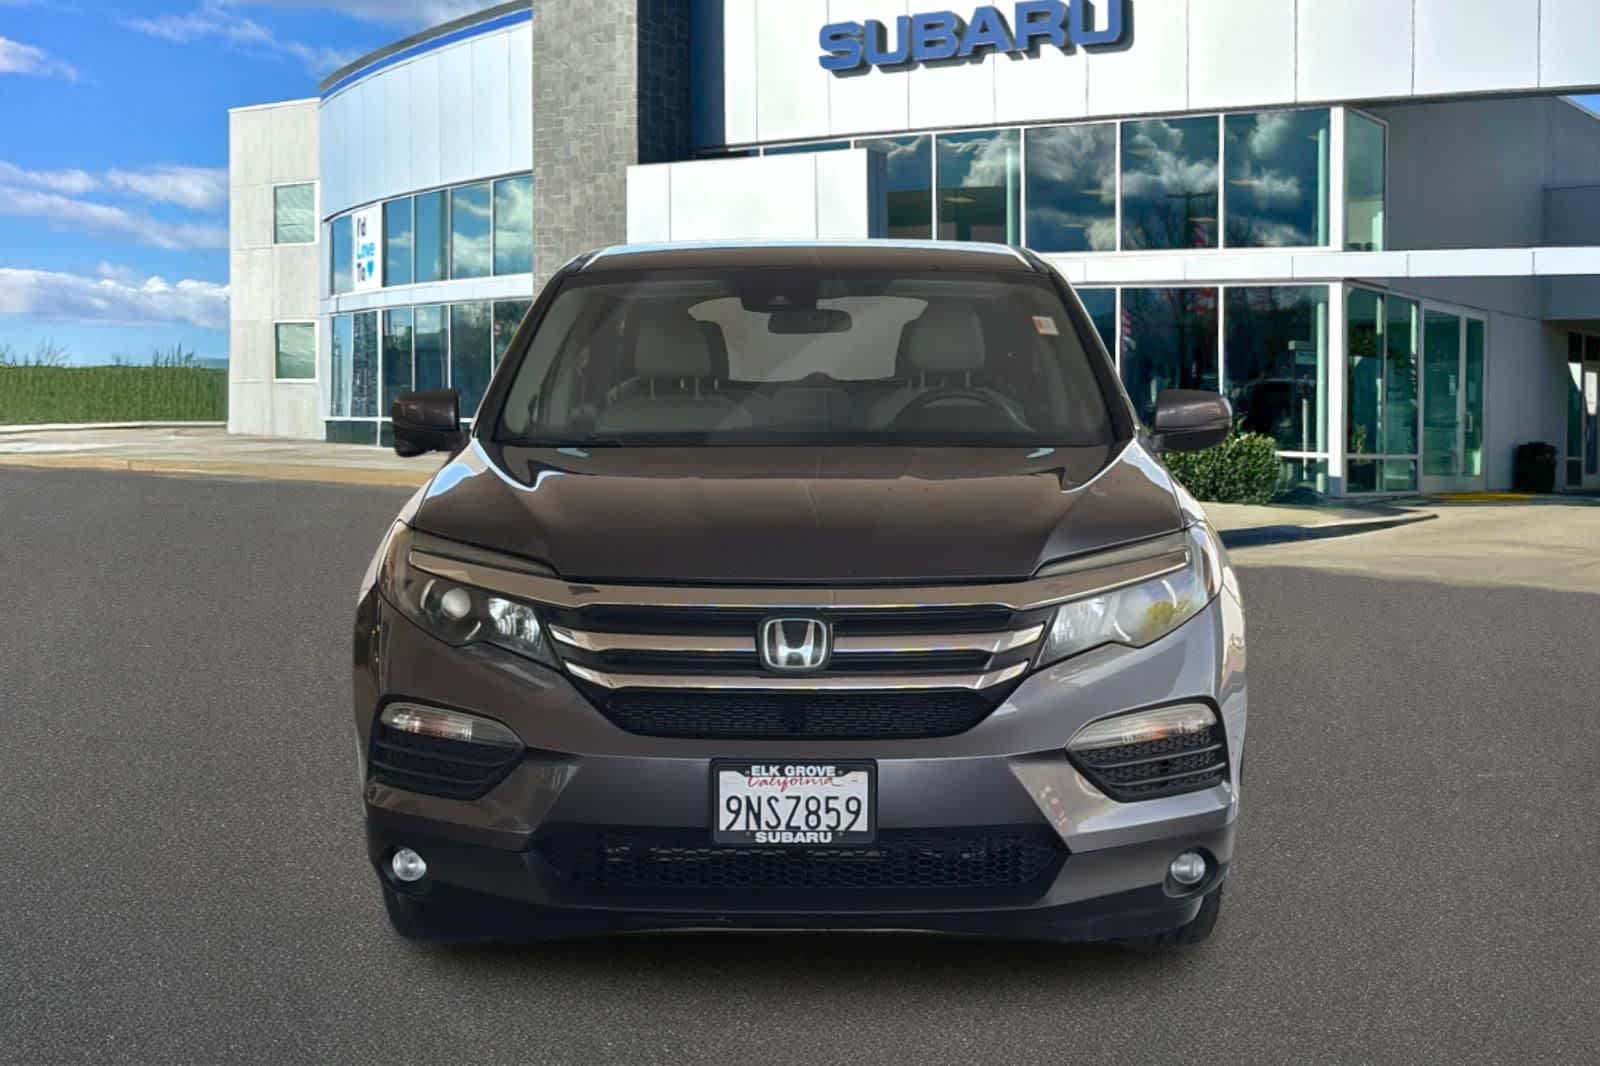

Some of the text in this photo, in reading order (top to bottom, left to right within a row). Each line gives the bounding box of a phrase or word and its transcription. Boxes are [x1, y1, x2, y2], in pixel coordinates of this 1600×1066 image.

[819, 0, 1128, 74] SUBARU
[751, 765, 836, 777] ELK GROVE
[725, 795, 862, 831] 9NSZ859
[755, 831, 833, 844] SUBARU
